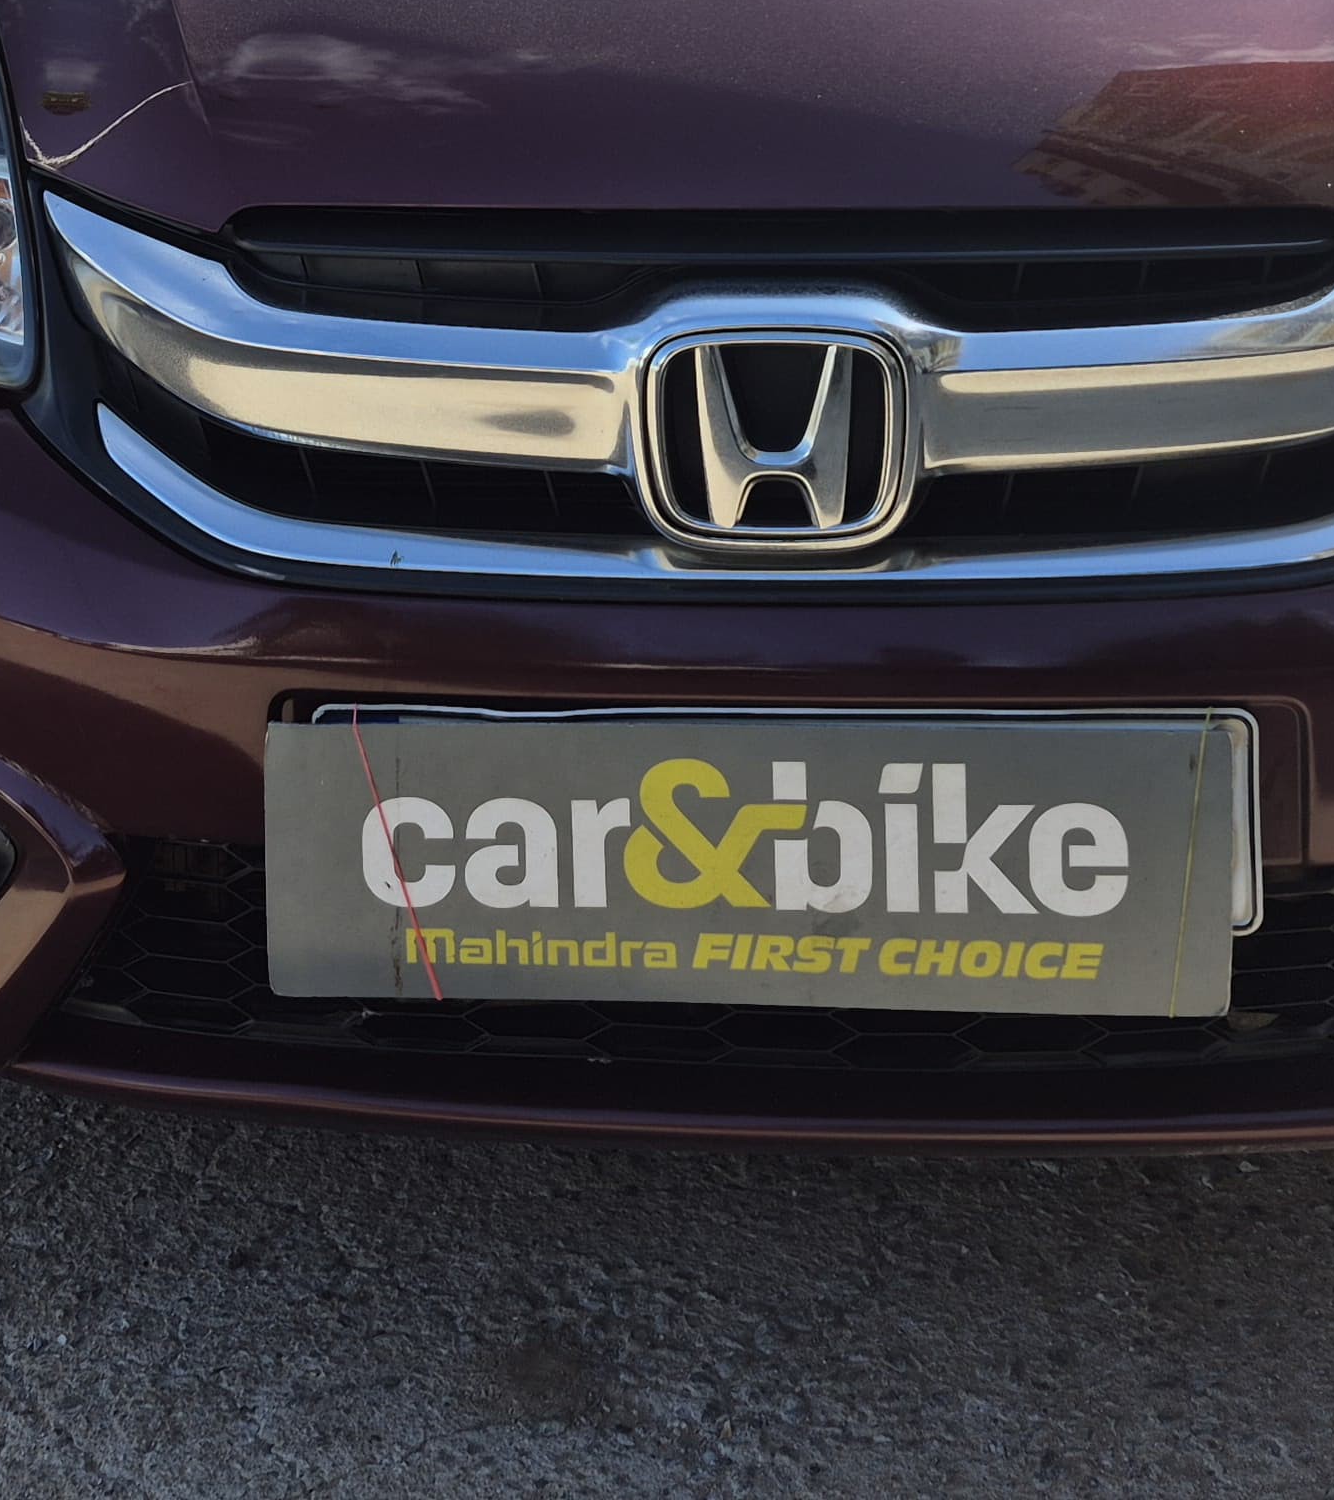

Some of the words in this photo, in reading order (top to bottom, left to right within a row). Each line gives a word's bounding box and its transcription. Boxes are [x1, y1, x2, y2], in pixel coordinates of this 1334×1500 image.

[362, 758, 1129, 917] car&bike
[405, 927, 678, 969] Mahindra
[692, 932, 872, 974] FIRST
[878, 937, 1105, 980] CHOICE
